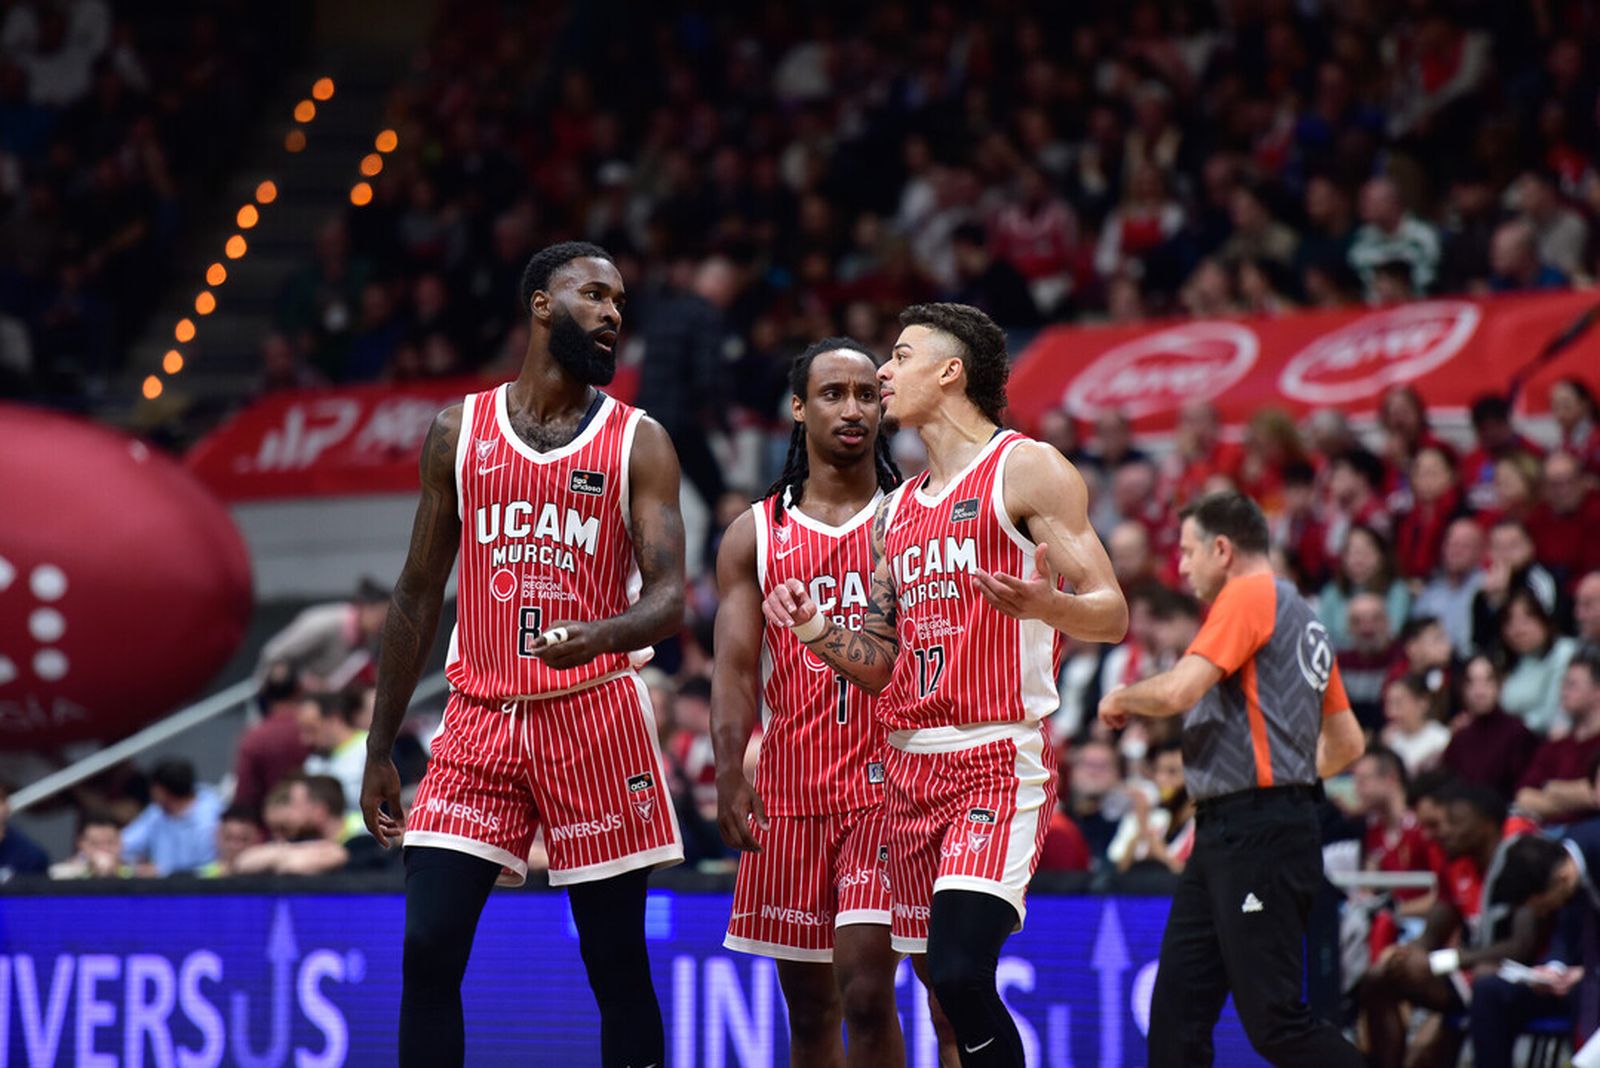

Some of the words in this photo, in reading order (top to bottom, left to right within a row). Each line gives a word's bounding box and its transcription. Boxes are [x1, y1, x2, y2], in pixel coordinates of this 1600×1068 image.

[477, 501, 600, 556] UCAM
[492, 544, 575, 573] MURCIA
[523, 589, 536, 599] DE
[538, 590, 578, 602] MURCIA
[809, 572, 875, 611] CA
[518, 606, 542, 658] 8
[914, 645, 945, 699] 12
[834, 675, 849, 724] 1
[631, 780, 648, 791] acb
[426, 798, 499, 831] INVERSUS
[550, 812, 622, 842] INVERSUS
[970, 813, 989, 822] acb
[761, 905, 831, 926] INVERSUS
[895, 903, 931, 920] INVER
